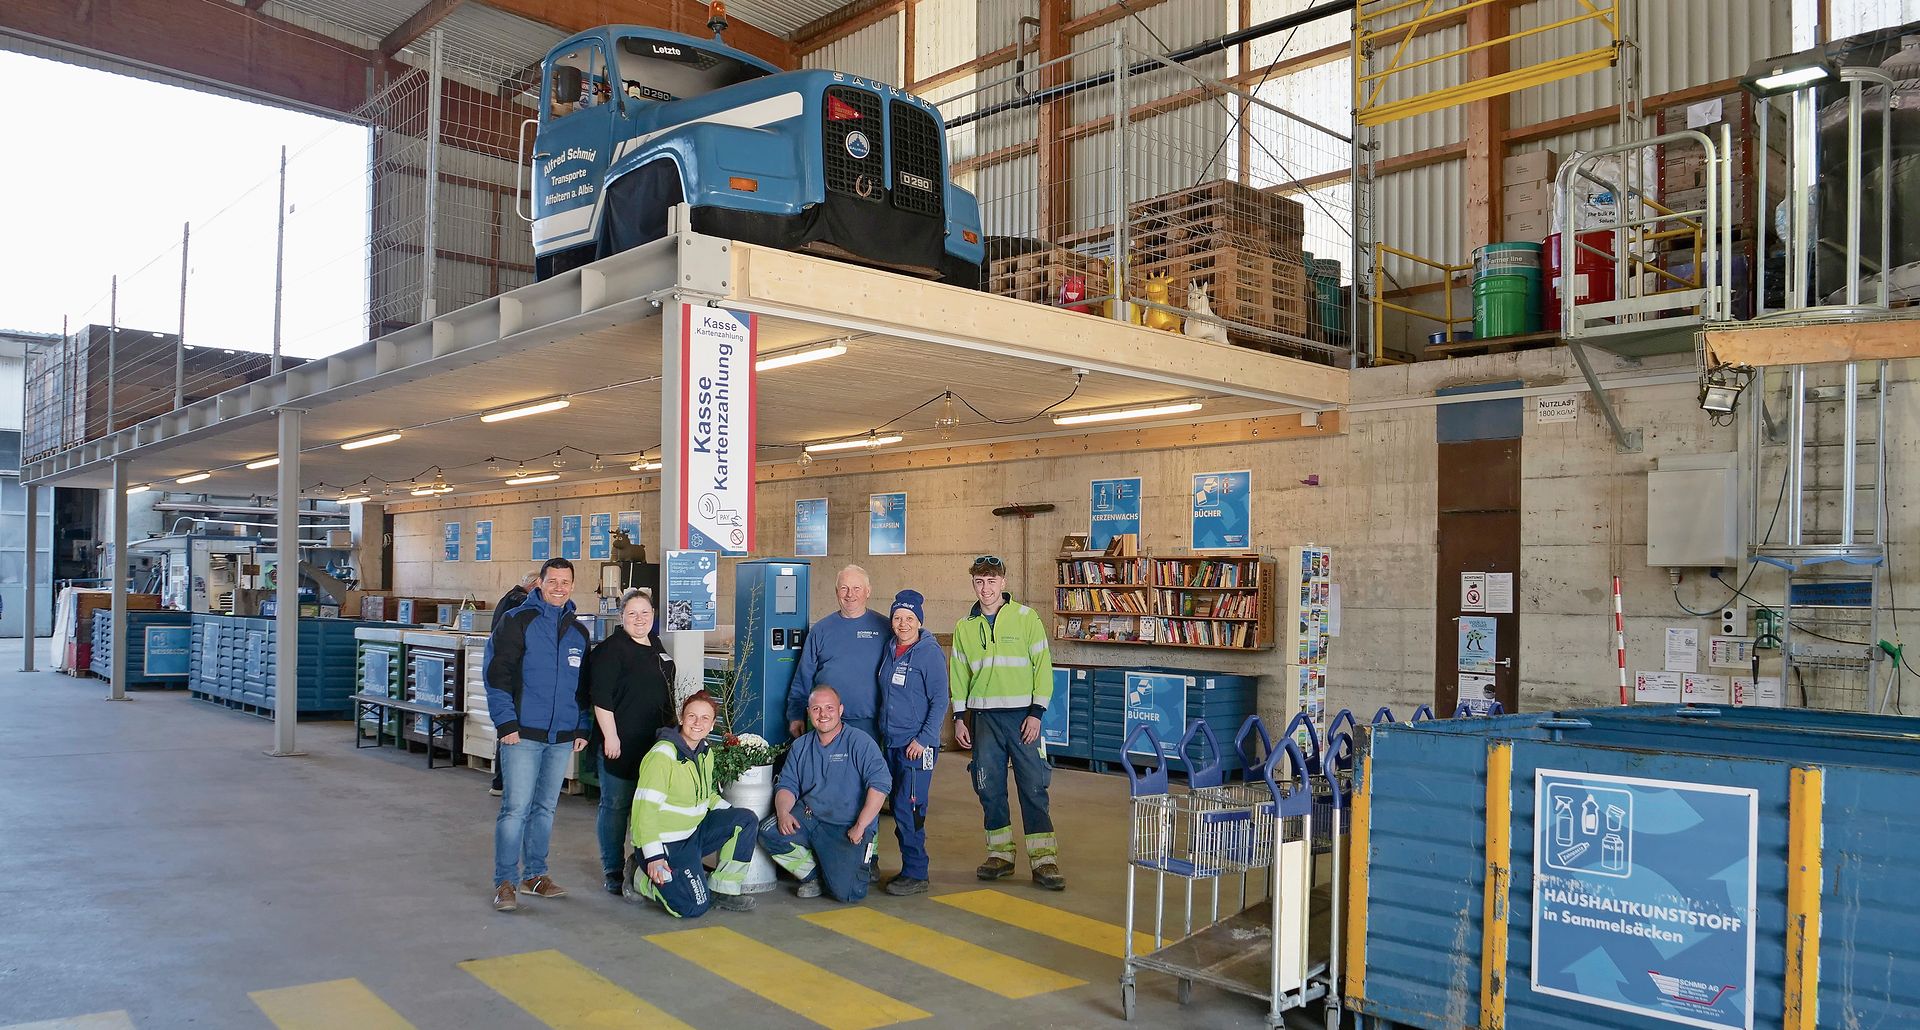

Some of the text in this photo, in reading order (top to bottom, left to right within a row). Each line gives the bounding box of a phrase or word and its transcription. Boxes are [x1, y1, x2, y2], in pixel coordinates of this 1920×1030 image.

[652, 45, 681, 56] Letzte
[833, 72, 931, 110] SAURER
[543, 147, 597, 177] Alfred Schmid
[551, 169, 587, 186] Transporte
[903, 175, 929, 189] D 290
[578, 183, 594, 197] Albis
[703, 316, 738, 332] Kasse
[696, 327, 744, 342] Kartenzahlung
[1539, 399, 1575, 408] NUTZLAST
[693, 376, 712, 454] Kasse
[714, 343, 733, 490] Kartenzahlung
[1539, 409, 1556, 417] 1800
[1092, 512, 1139, 521] KERZENWACHS
[1194, 508, 1222, 518] BÜCHER
[1127, 709, 1160, 722] BÜCHER
[1544, 888, 1741, 933] HAUSHALTKUNSTSTOFF
[1544, 907, 1683, 943] in Sammelsäcken
[1680, 979, 1720, 992] SCHMID AG
